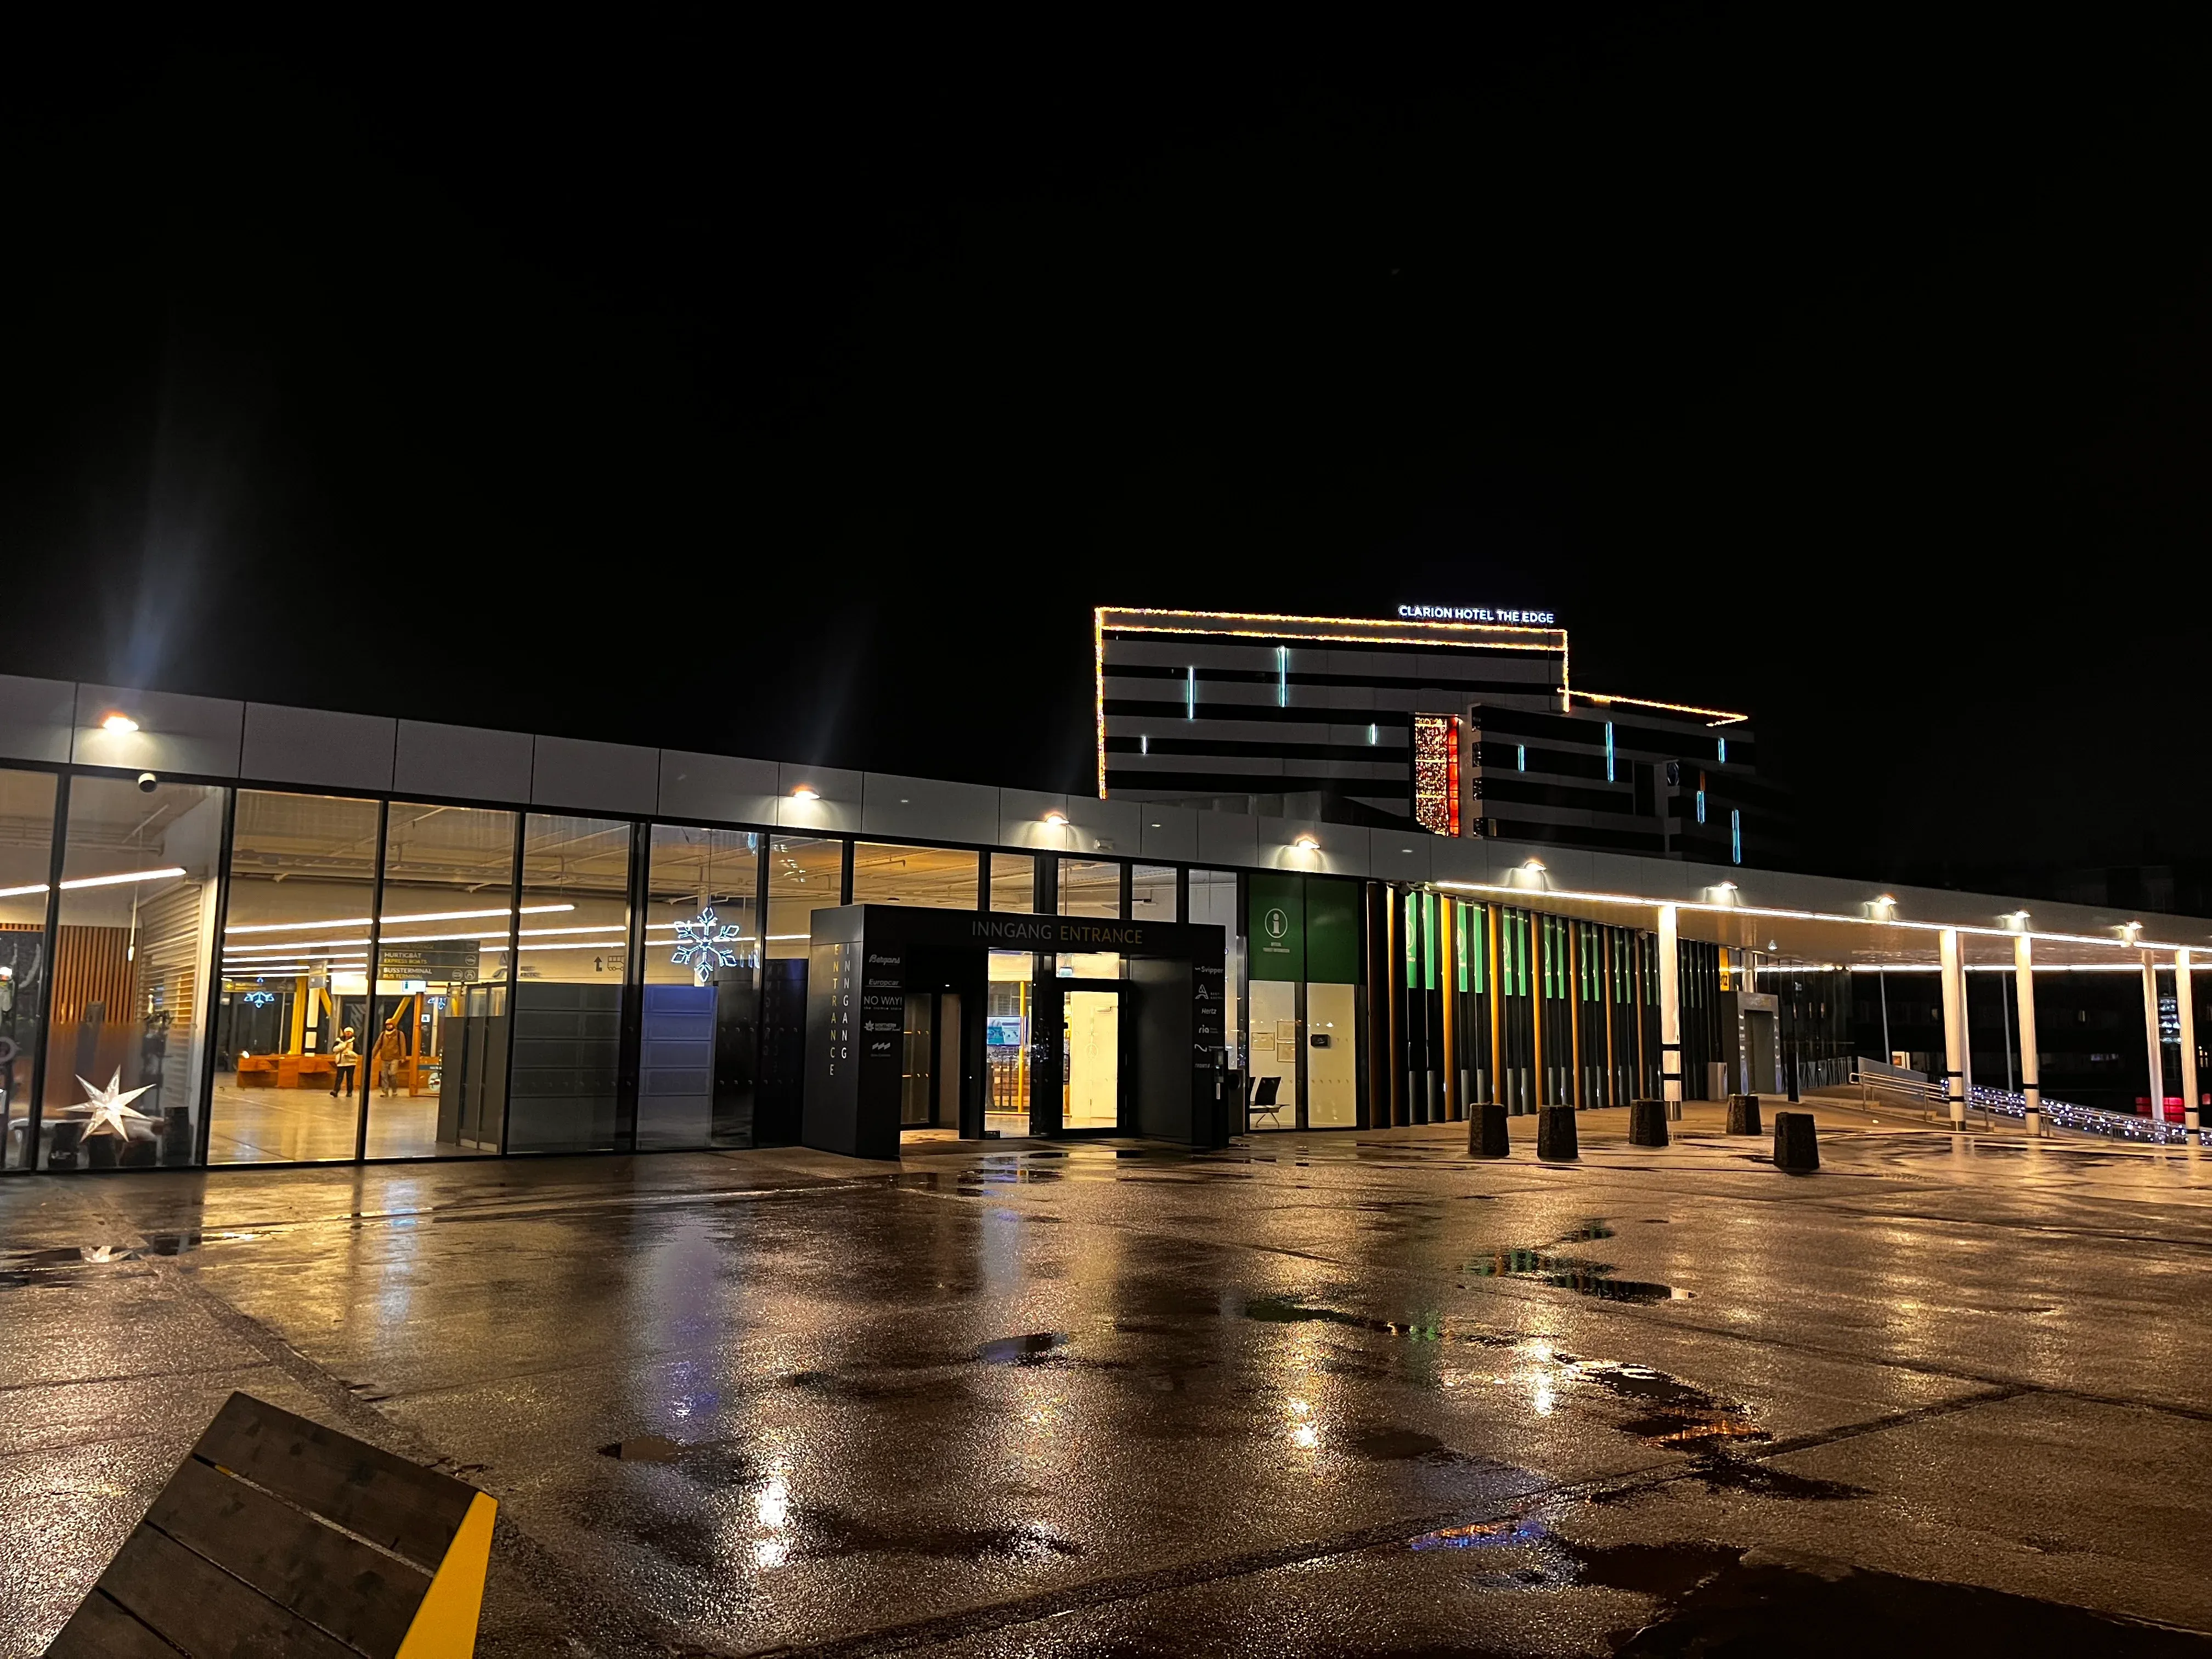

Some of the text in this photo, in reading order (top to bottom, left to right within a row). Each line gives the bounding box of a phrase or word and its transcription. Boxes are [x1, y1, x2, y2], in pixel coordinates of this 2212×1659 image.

[1398, 605, 1554, 624] CLARION HOTEL THE EDGE
[972, 921, 1143, 944] INNGANG ENTRANCE
[868, 954, 900, 966] Bergans
[1201, 966, 1224, 975] Svipper
[841, 943, 850, 1059] INNGANG
[864, 996, 902, 1006] NO WAY!
[830, 944, 839, 1076] ENTRANCE
[1198, 1024, 1210, 1034] ria
